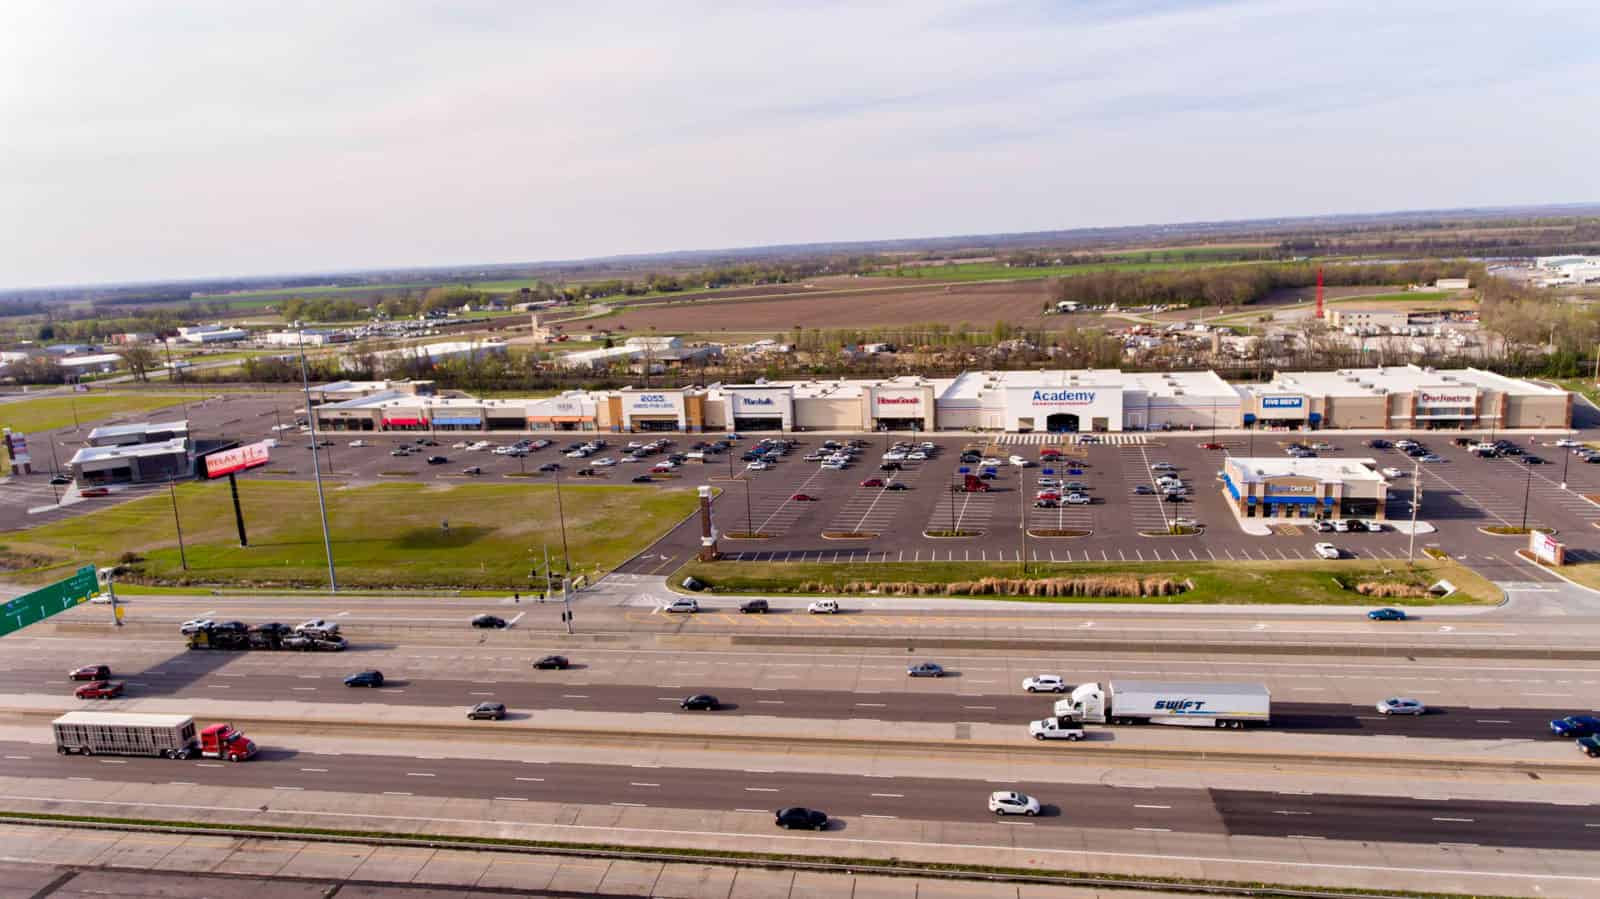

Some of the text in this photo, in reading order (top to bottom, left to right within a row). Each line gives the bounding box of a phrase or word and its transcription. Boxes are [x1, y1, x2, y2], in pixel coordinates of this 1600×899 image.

[1032, 390, 1095, 404] Academy
[207, 456, 236, 467] RELAX
[1154, 699, 1206, 710] SWIFT
